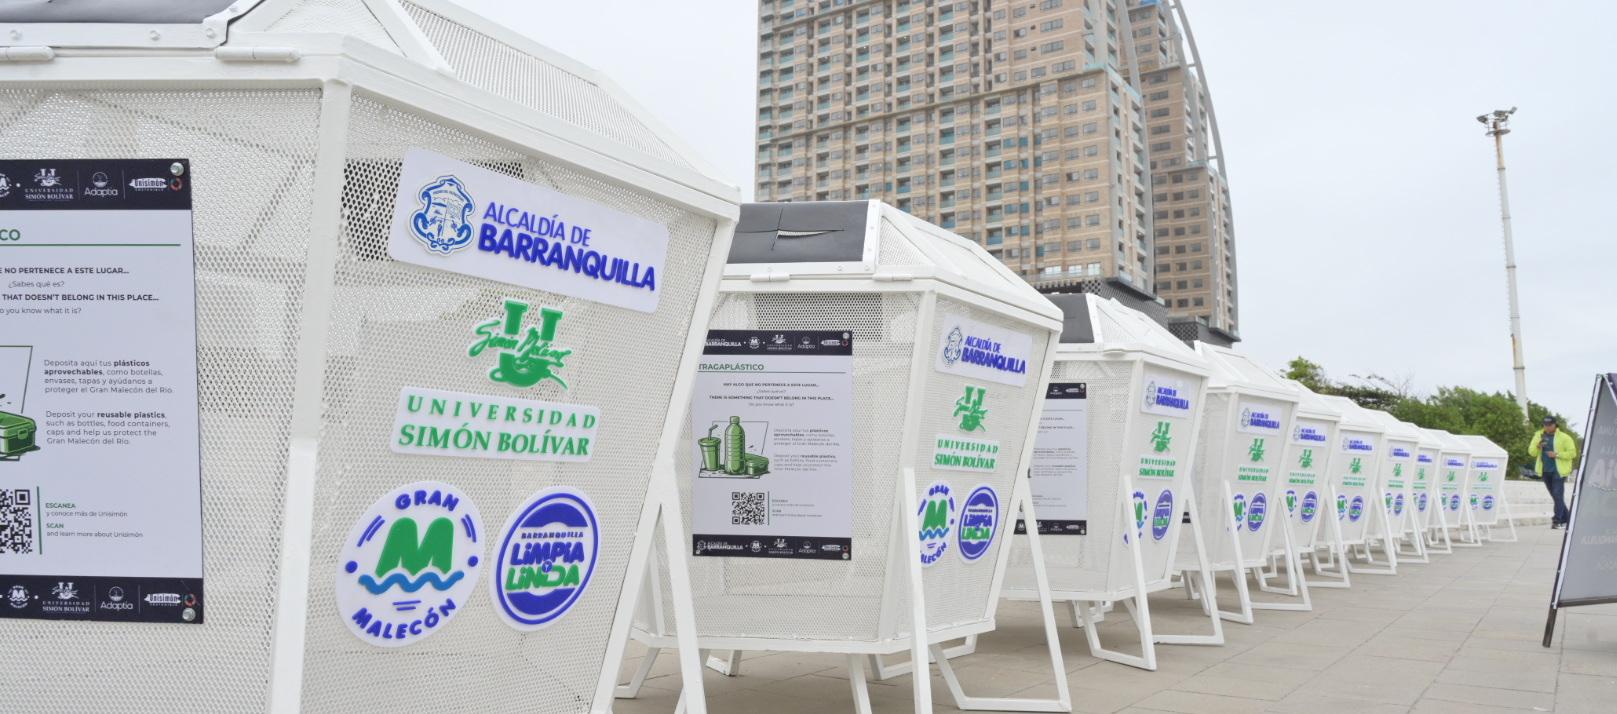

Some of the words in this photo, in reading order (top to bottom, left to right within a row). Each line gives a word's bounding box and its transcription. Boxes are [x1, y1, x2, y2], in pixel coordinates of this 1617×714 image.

[483, 201, 565, 241] ALCALDÍA
[570, 226, 592, 247] DE
[478, 223, 656, 291] BARRANQUILLA
[52, 280, 65, 288] es?
[6, 308, 20, 316] you
[964, 336, 992, 352] ALCALDÍA
[44, 359, 79, 368] Deposita
[113, 359, 151, 368] plásticos
[961, 347, 1026, 374] BARRANQUILLA
[45, 386, 78, 394] proteger
[46, 410, 76, 419] Deposit
[77, 411, 95, 419] your
[407, 395, 596, 429] UNIVERSIDAD
[46, 429, 65, 437] caps
[83, 429, 101, 437] help
[113, 429, 142, 437] protect
[46, 437, 66, 445] Gran
[102, 437, 115, 445] del
[398, 423, 491, 451] SIMÓN
[497, 429, 590, 456] BOLÍVAR
[938, 440, 999, 453] UNIVERSIDAD
[935, 451, 961, 467] SIMÓN
[962, 454, 996, 469] BOLÍVAR
[395, 490, 459, 511] GRAN
[352, 598, 456, 639] MALECÓN
